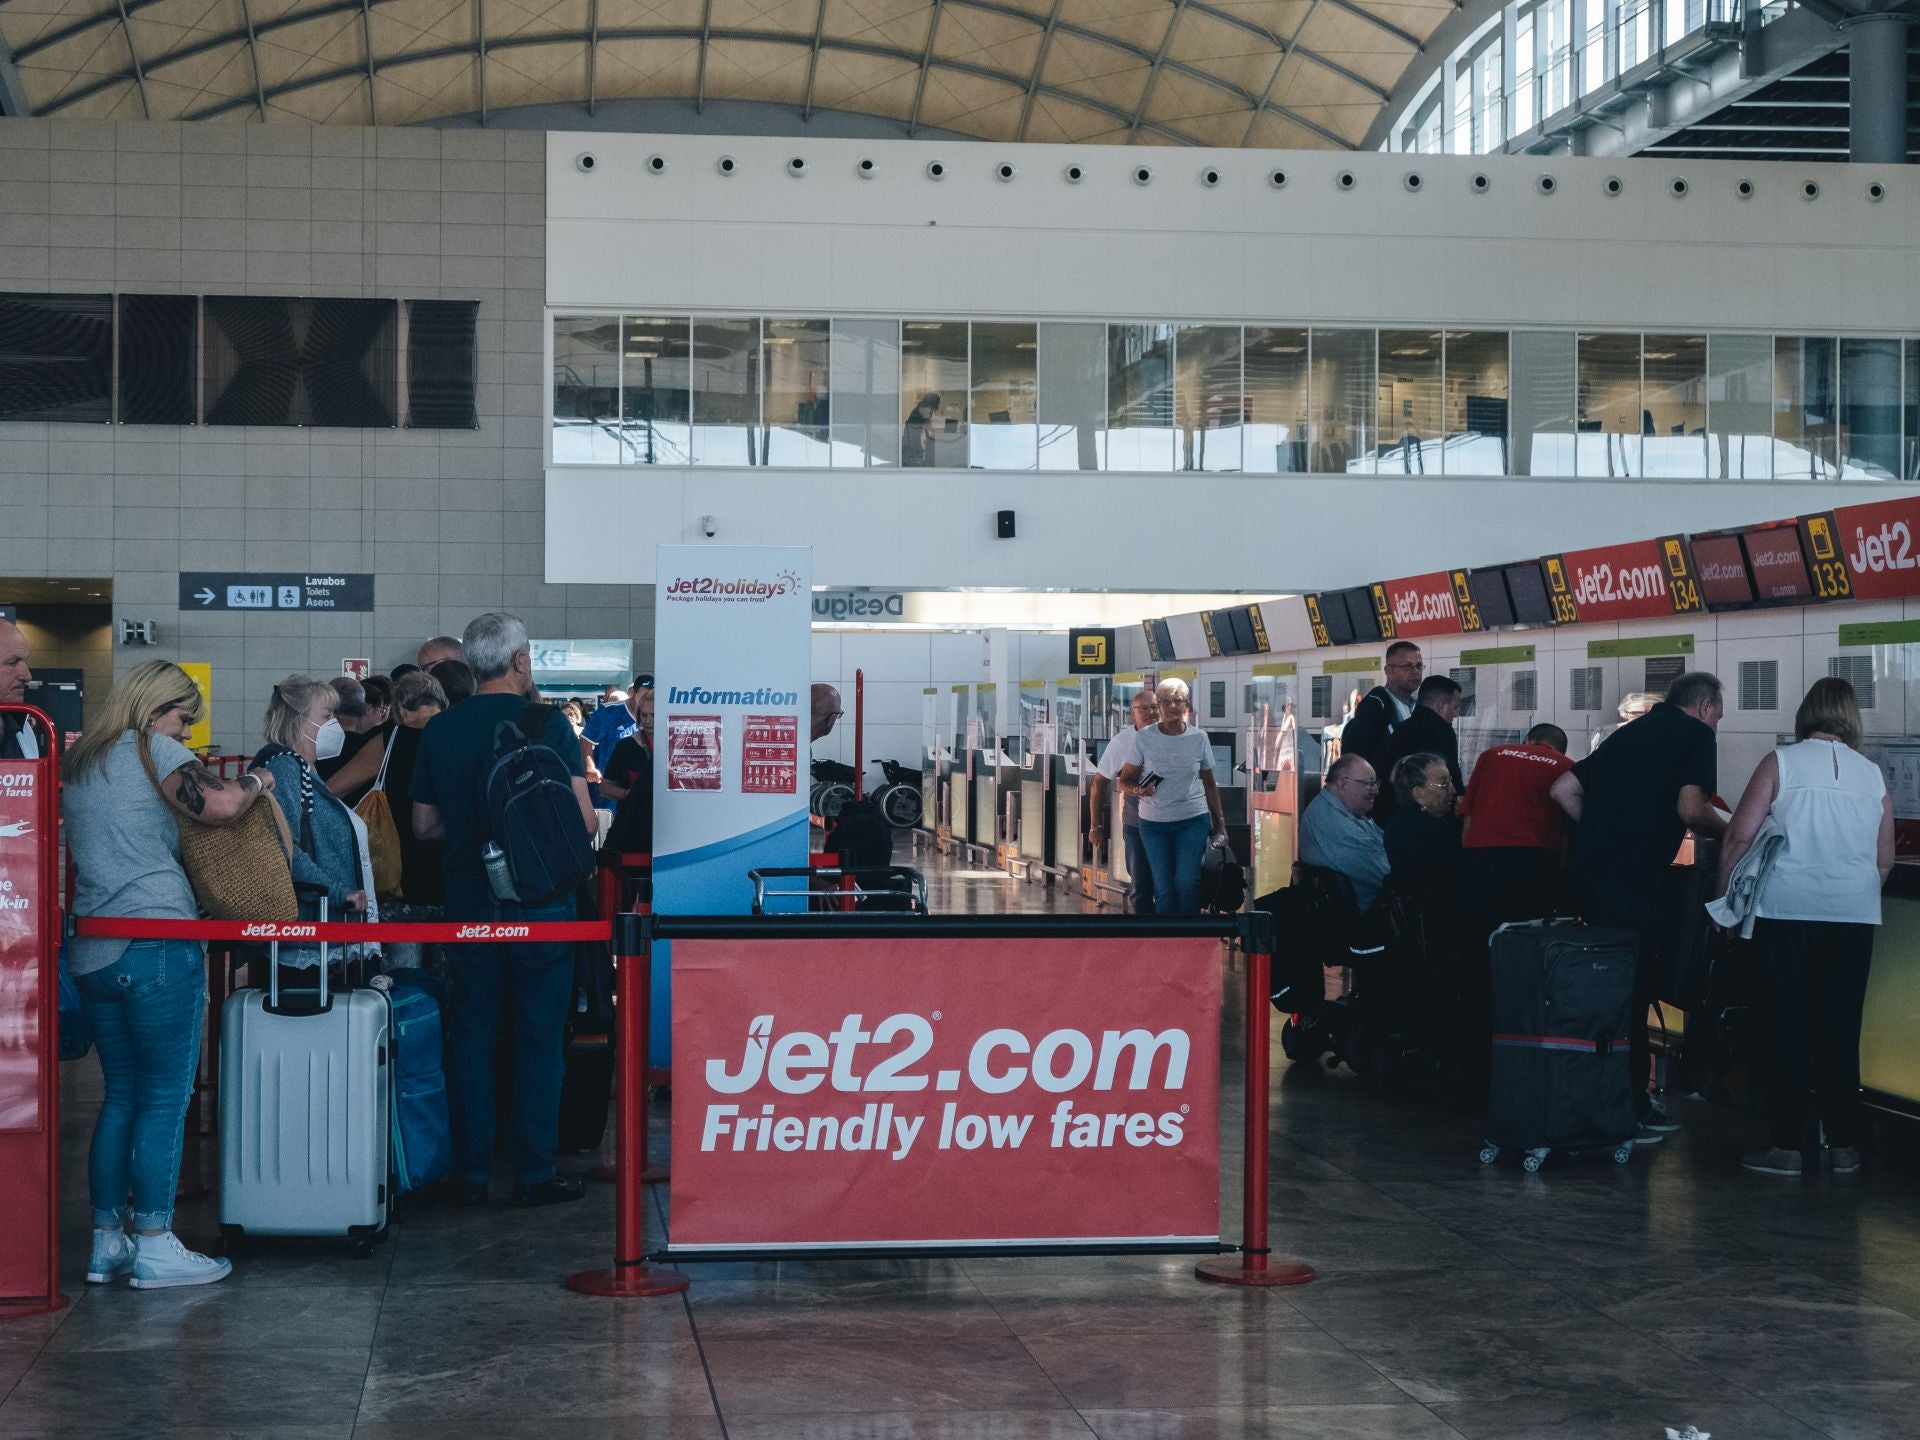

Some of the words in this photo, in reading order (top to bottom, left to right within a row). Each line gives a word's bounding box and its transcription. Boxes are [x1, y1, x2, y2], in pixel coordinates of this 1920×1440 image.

[1754, 551, 1801, 567] Jet2.com
[305, 576, 346, 586] Lavabos
[1700, 563, 1744, 581] Jet2.com
[1812, 561, 1850, 598] 133
[305, 587, 331, 596] Toilets
[666, 577, 786, 599] Jet2holidays
[1574, 563, 1666, 605] Jet2.com
[1772, 584, 1797, 597] CLOSED
[305, 598, 335, 607] Aseos
[666, 595, 694, 603] Package
[695, 595, 722, 603] holidays
[723, 596, 735, 604] you
[1669, 579, 1700, 611] 134
[1393, 590, 1456, 624] Jet2.com
[1459, 604, 1481, 630] 136
[1552, 594, 1577, 622] 135
[1312, 623, 1329, 646] 138
[1378, 615, 1395, 638] 137
[1255, 630, 1269, 651] 139
[668, 686, 799, 706] Information
[674, 726, 716, 735] DEVICES
[1497, 748, 1558, 766] Jet2.com
[6, 787, 33, 797] fares
[241, 923, 317, 937] Jet2.com
[455, 924, 529, 938] Jet2.com
[705, 1012, 1191, 1094] Jet2.com
[700, 1102, 925, 1161] Friendly
[938, 1101, 1034, 1150] low
[1050, 1099, 1188, 1148] fares
